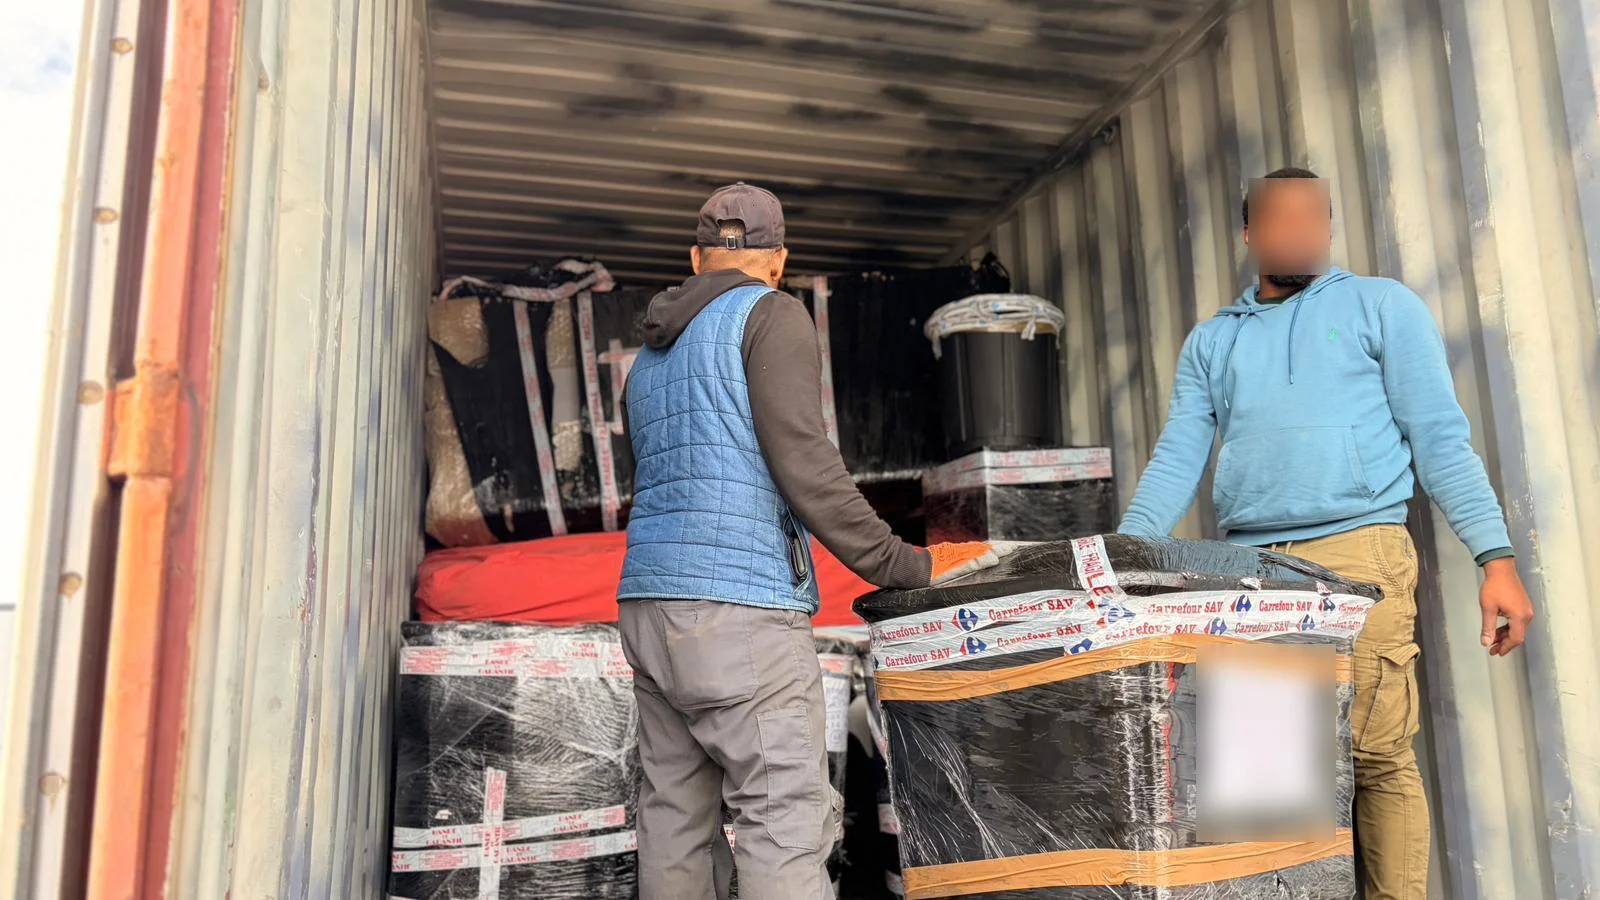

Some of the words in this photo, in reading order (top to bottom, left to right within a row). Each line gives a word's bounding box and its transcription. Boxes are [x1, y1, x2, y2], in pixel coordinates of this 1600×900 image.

[989, 602, 1044, 621] Carrefour
[1046, 598, 1075, 611] SAV
[1204, 601, 1224, 612] SAV
[1259, 600, 1292, 612] Carrefour
[1295, 601, 1312, 612] SAV
[922, 620, 944, 634] SAV
[1174, 624, 1197, 635] SAV
[1235, 622, 1272, 634] Carrefour
[885, 653, 928, 668] Carrefour
[930, 648, 950, 661] SAV
